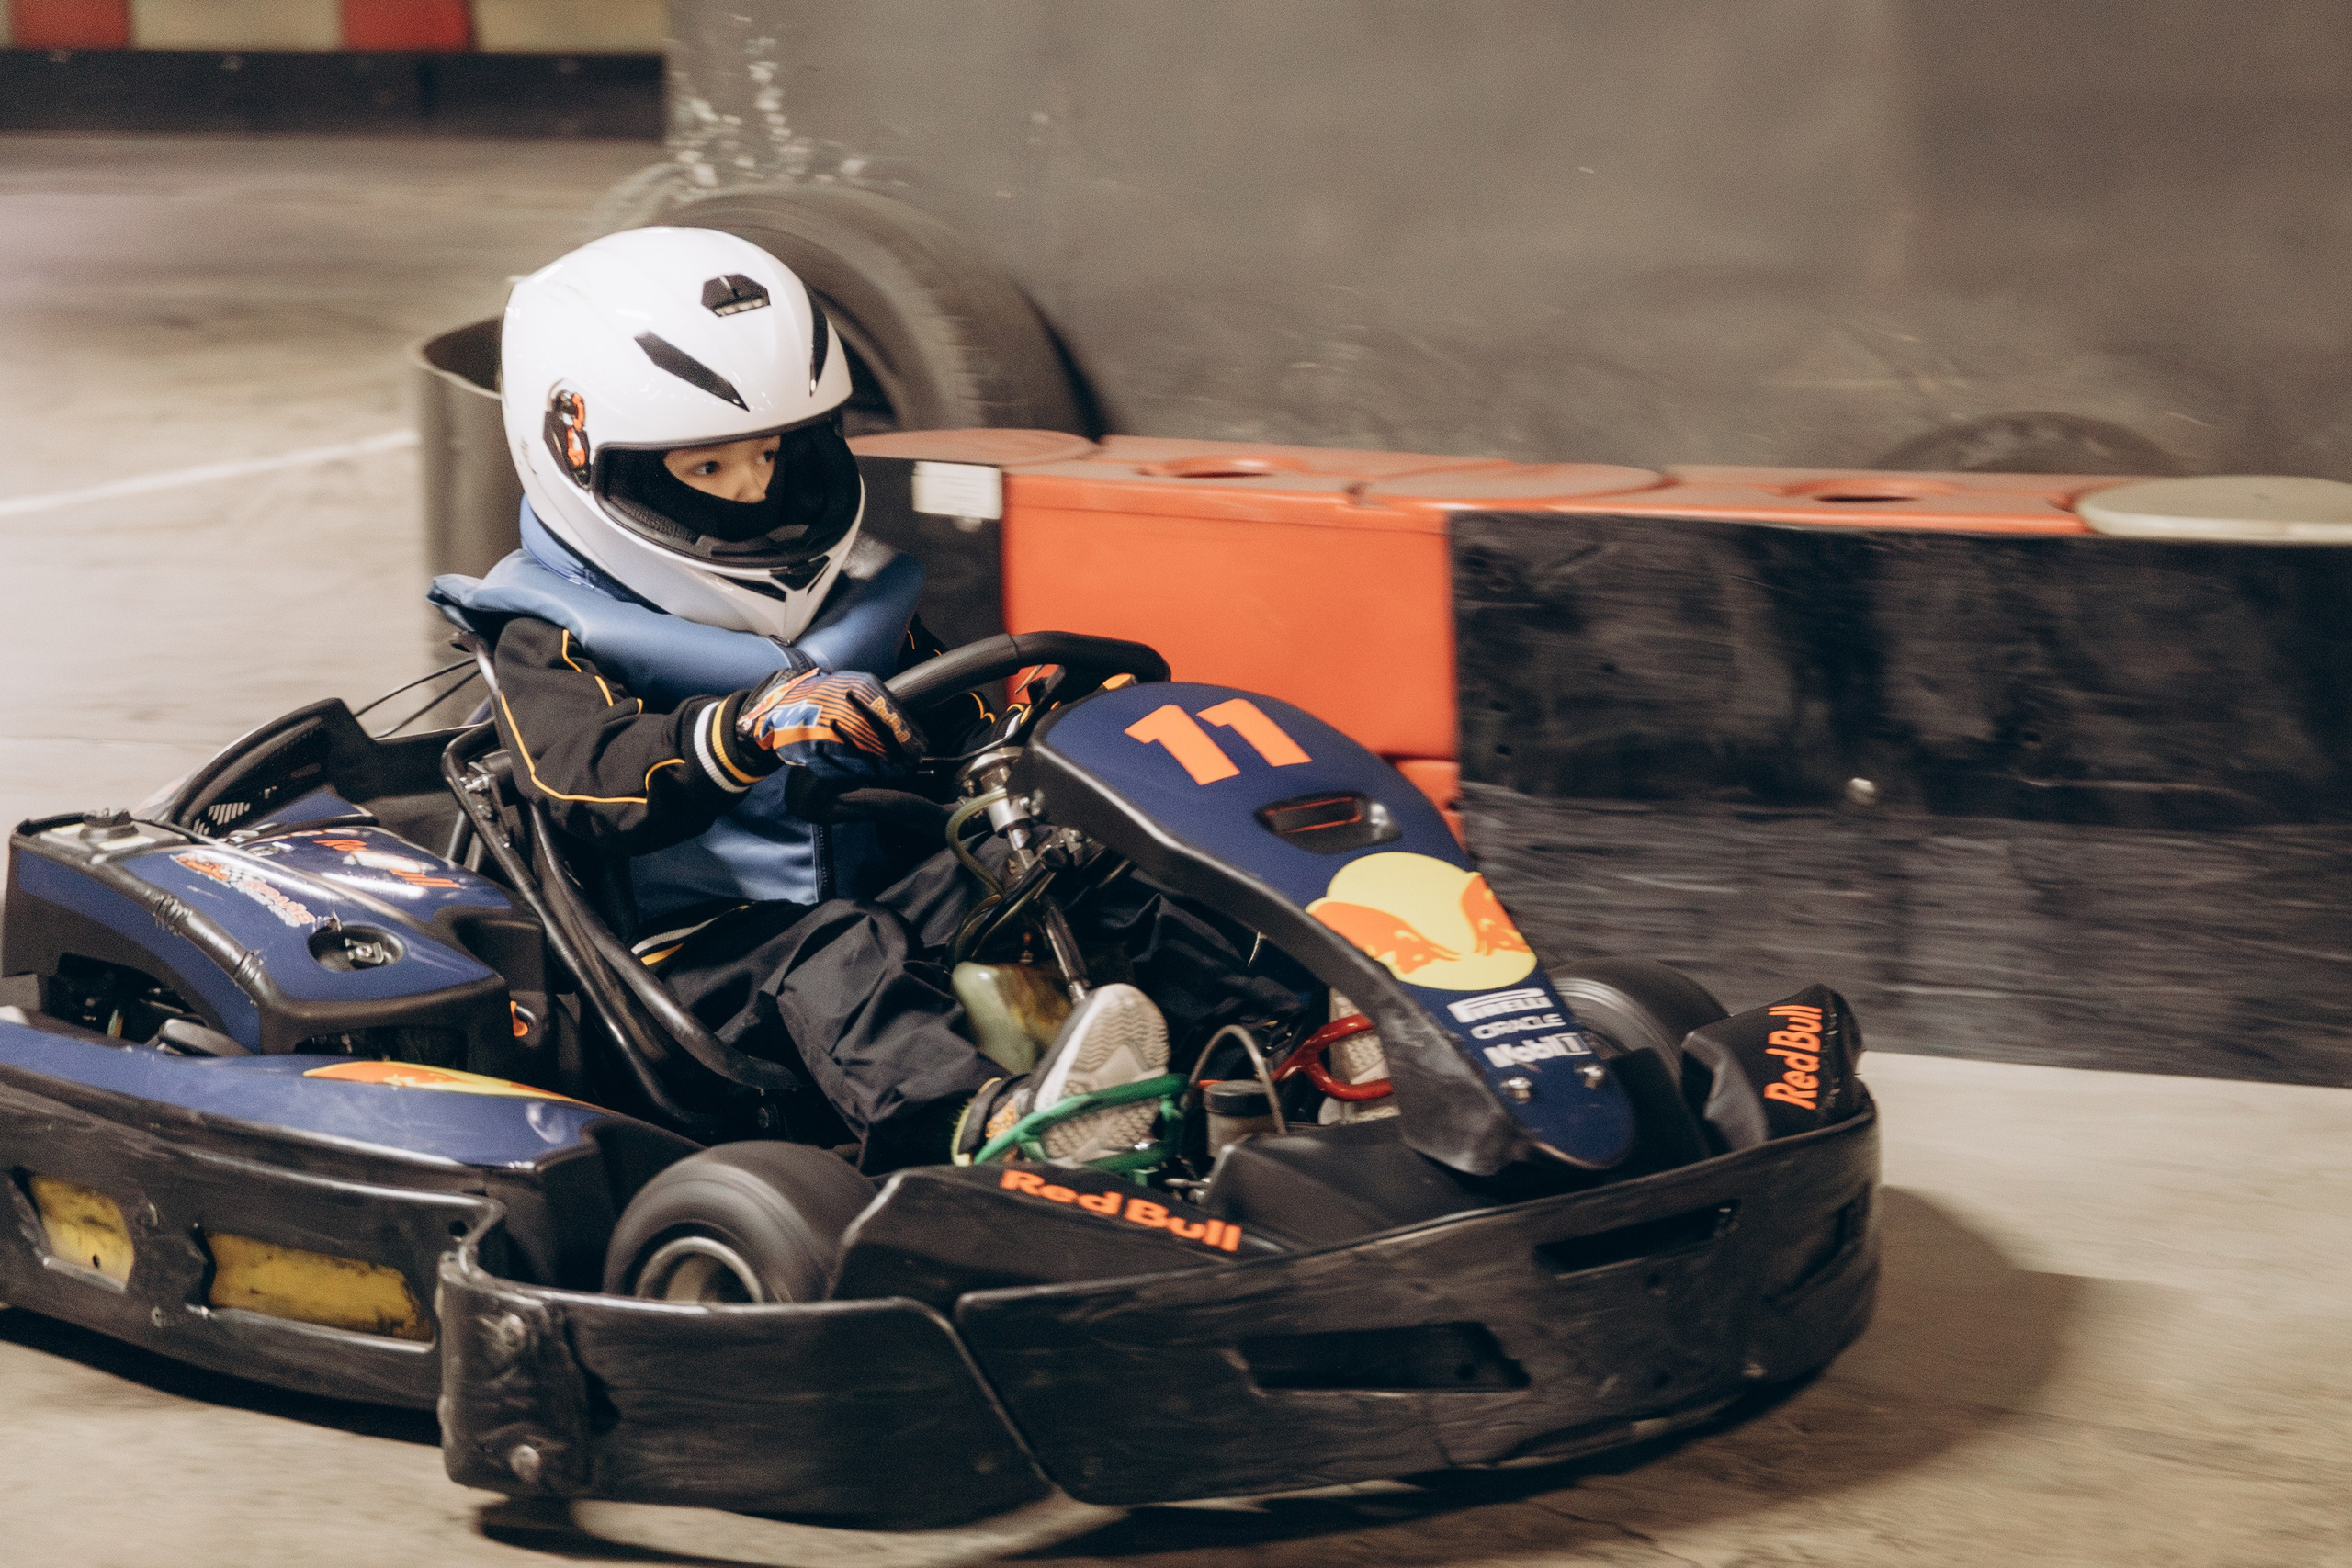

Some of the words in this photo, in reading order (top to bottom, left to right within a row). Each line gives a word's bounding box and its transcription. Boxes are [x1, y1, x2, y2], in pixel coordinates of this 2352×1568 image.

[1124, 698, 1313, 785] 11
[1471, 1013, 1566, 1039] ORACLE
[1768, 1005, 1823, 1052] Bull
[1764, 1048, 1821, 1110] Red
[999, 1169, 1123, 1215] Red
[1125, 1198, 1242, 1252] Bull
